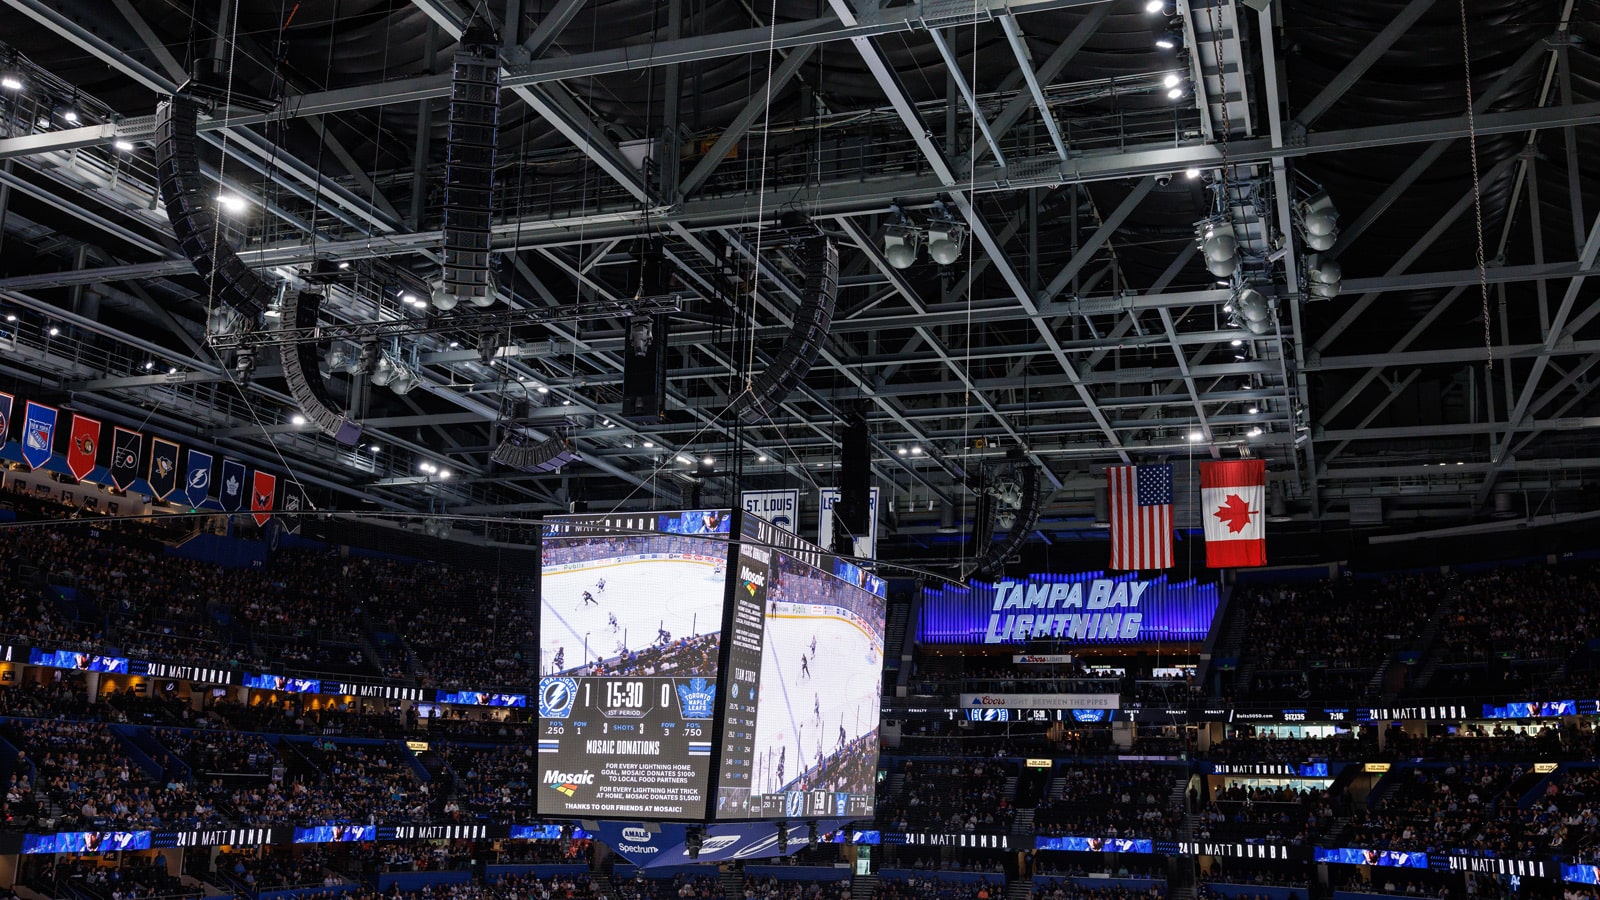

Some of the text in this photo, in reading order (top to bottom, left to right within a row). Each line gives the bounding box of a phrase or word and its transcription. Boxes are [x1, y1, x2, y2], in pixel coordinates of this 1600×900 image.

[747, 498, 792, 512] ST. LOUIS
[575, 520, 601, 532] MATT
[741, 566, 764, 588] Mosaic
[992, 578, 1150, 611] TAMPA BAY
[984, 612, 1144, 644] LIGHTNING
[169, 666, 192, 678] MATT
[361, 686, 383, 696] MATT
[585, 684, 590, 706] 1
[607, 682, 643, 707] 15:30
[661, 684, 669, 707] 0
[685, 692, 711, 701] TORONTO
[981, 696, 1005, 705] Coors
[1017, 709, 1021, 720] 1
[1393, 708, 1416, 719] MATT
[603, 723, 607, 733] 3
[640, 723, 644, 734] 3
[586, 740, 659, 755] MOSAIC DONATIONS
[543, 770, 594, 785] Mosaic
[202, 831, 228, 846] MATT
[419, 827, 443, 838] MATT
[931, 834, 956, 845] MATT
[618, 843, 656, 854] Spectrum
[1205, 844, 1232, 855] MATT
[1472, 858, 1495, 872] MATT
